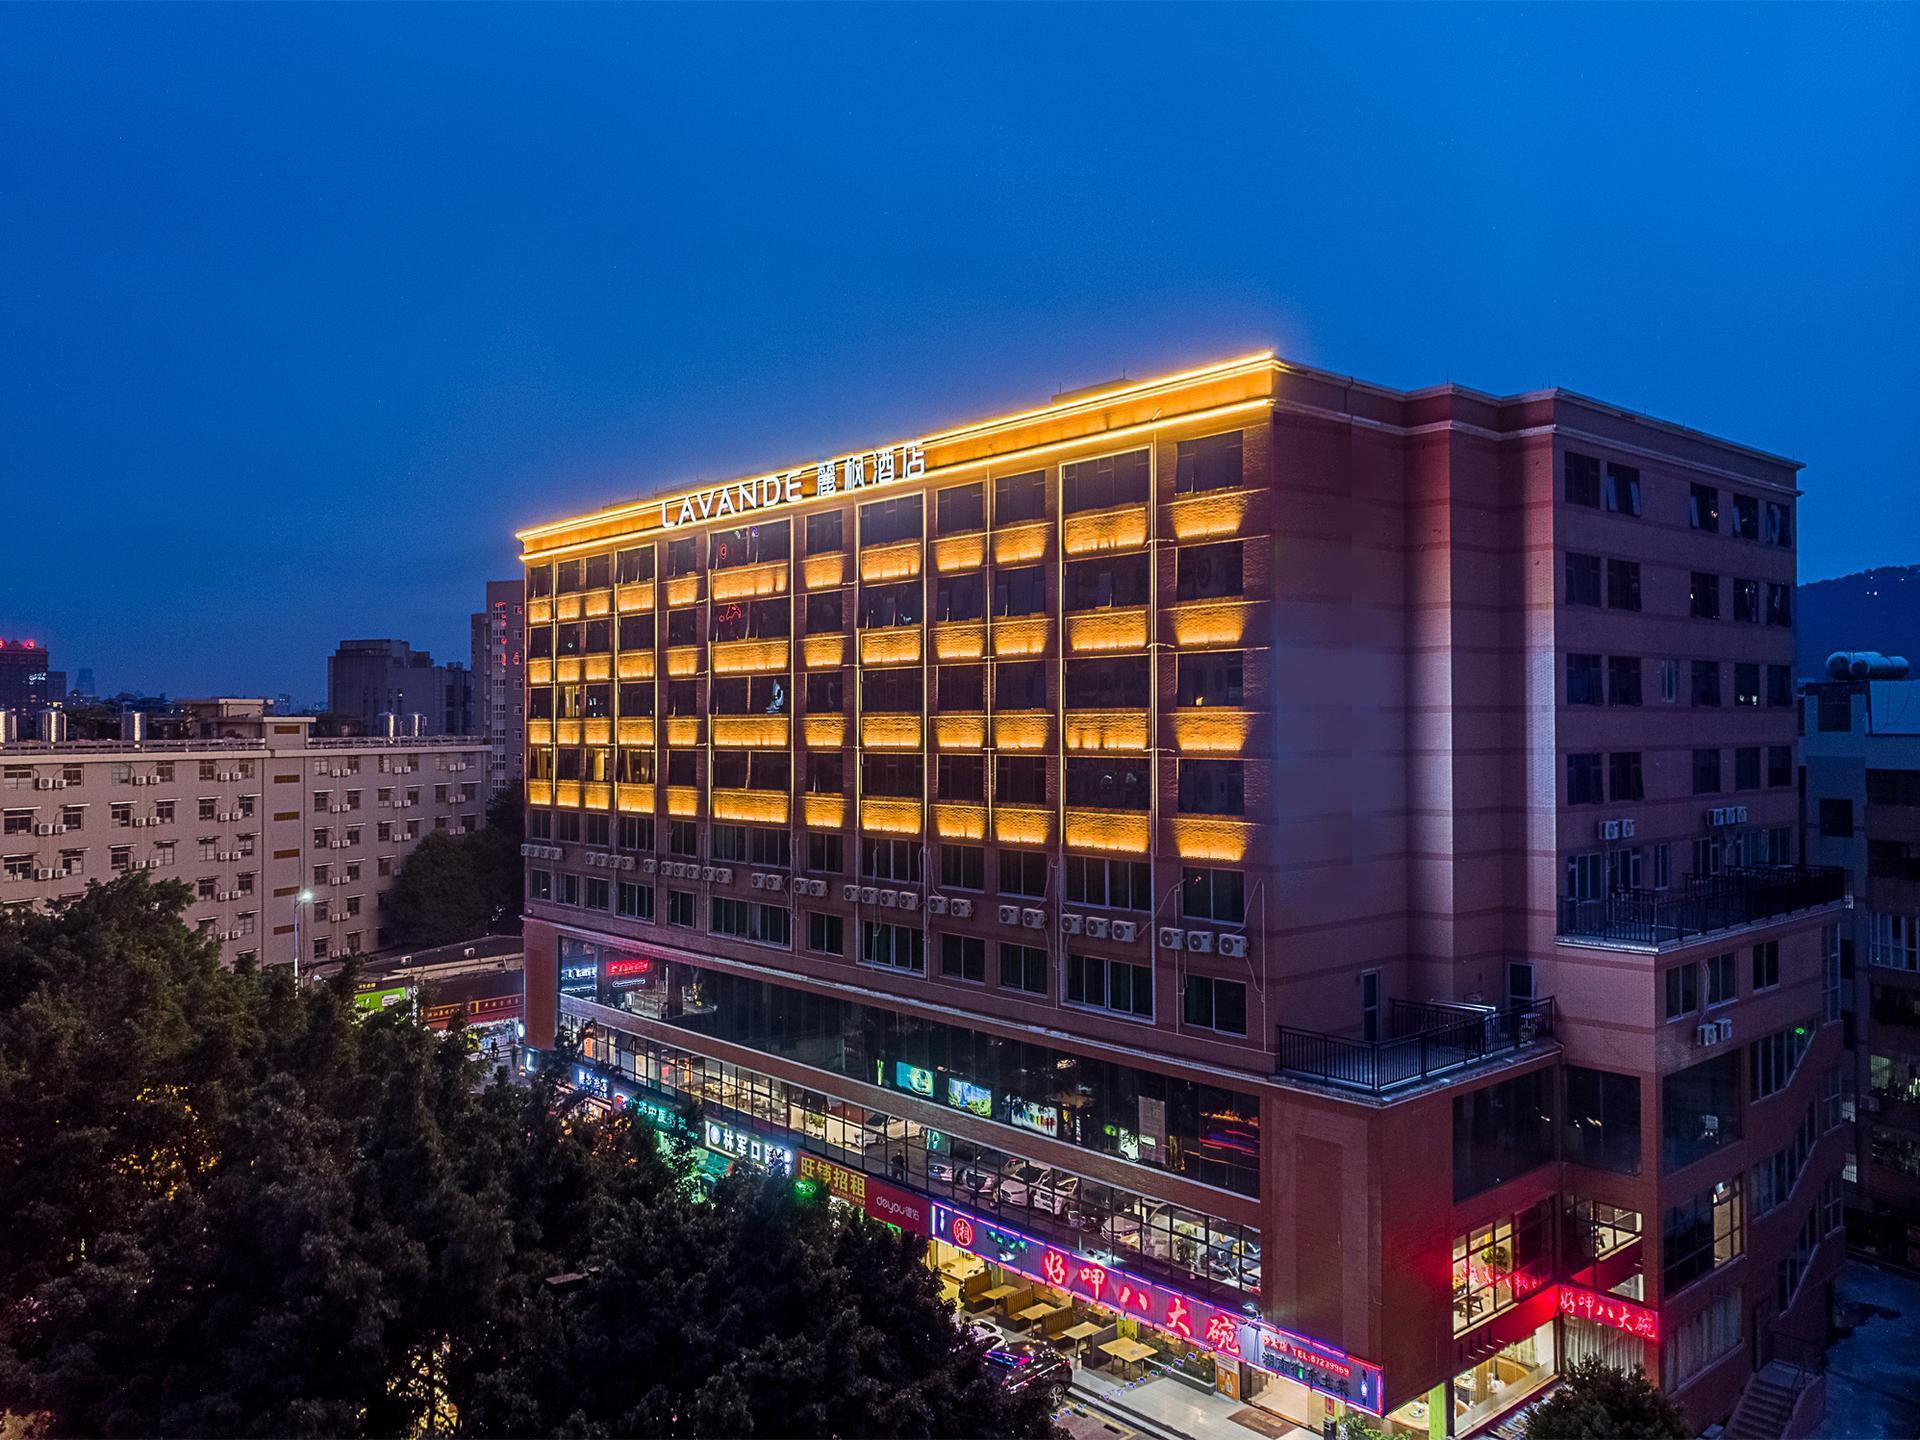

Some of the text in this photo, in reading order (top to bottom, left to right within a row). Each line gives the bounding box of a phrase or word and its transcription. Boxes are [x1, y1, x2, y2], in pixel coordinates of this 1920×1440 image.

[661, 472, 804, 528] LAVANDE
[801, 1157, 866, 1199] 旺铺招租
[876, 1196, 905, 1216] deyou
[1044, 1250, 1241, 1355] 好呷八大碗
[1560, 1291, 1656, 1338] 好呷八大碗
